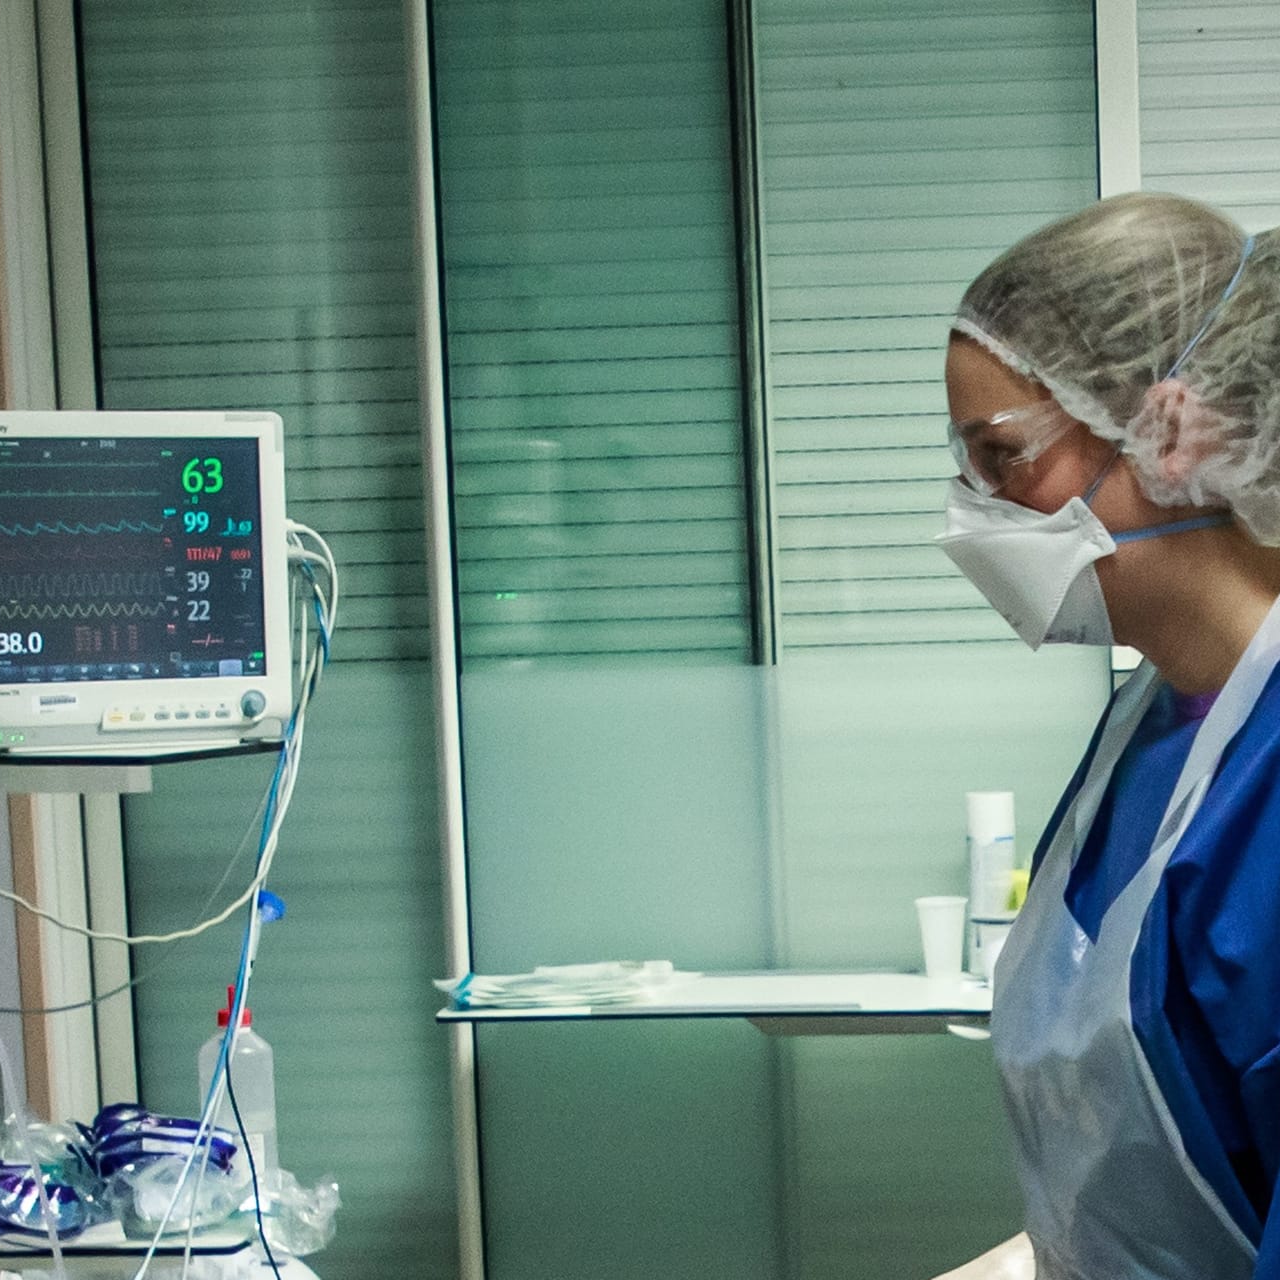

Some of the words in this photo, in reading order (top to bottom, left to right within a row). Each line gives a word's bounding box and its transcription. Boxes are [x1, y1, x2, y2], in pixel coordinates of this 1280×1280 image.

[182, 457, 224, 494] 63
[183, 511, 210, 533] 99
[186, 571, 210, 592] 39
[187, 600, 211, 621] 22
